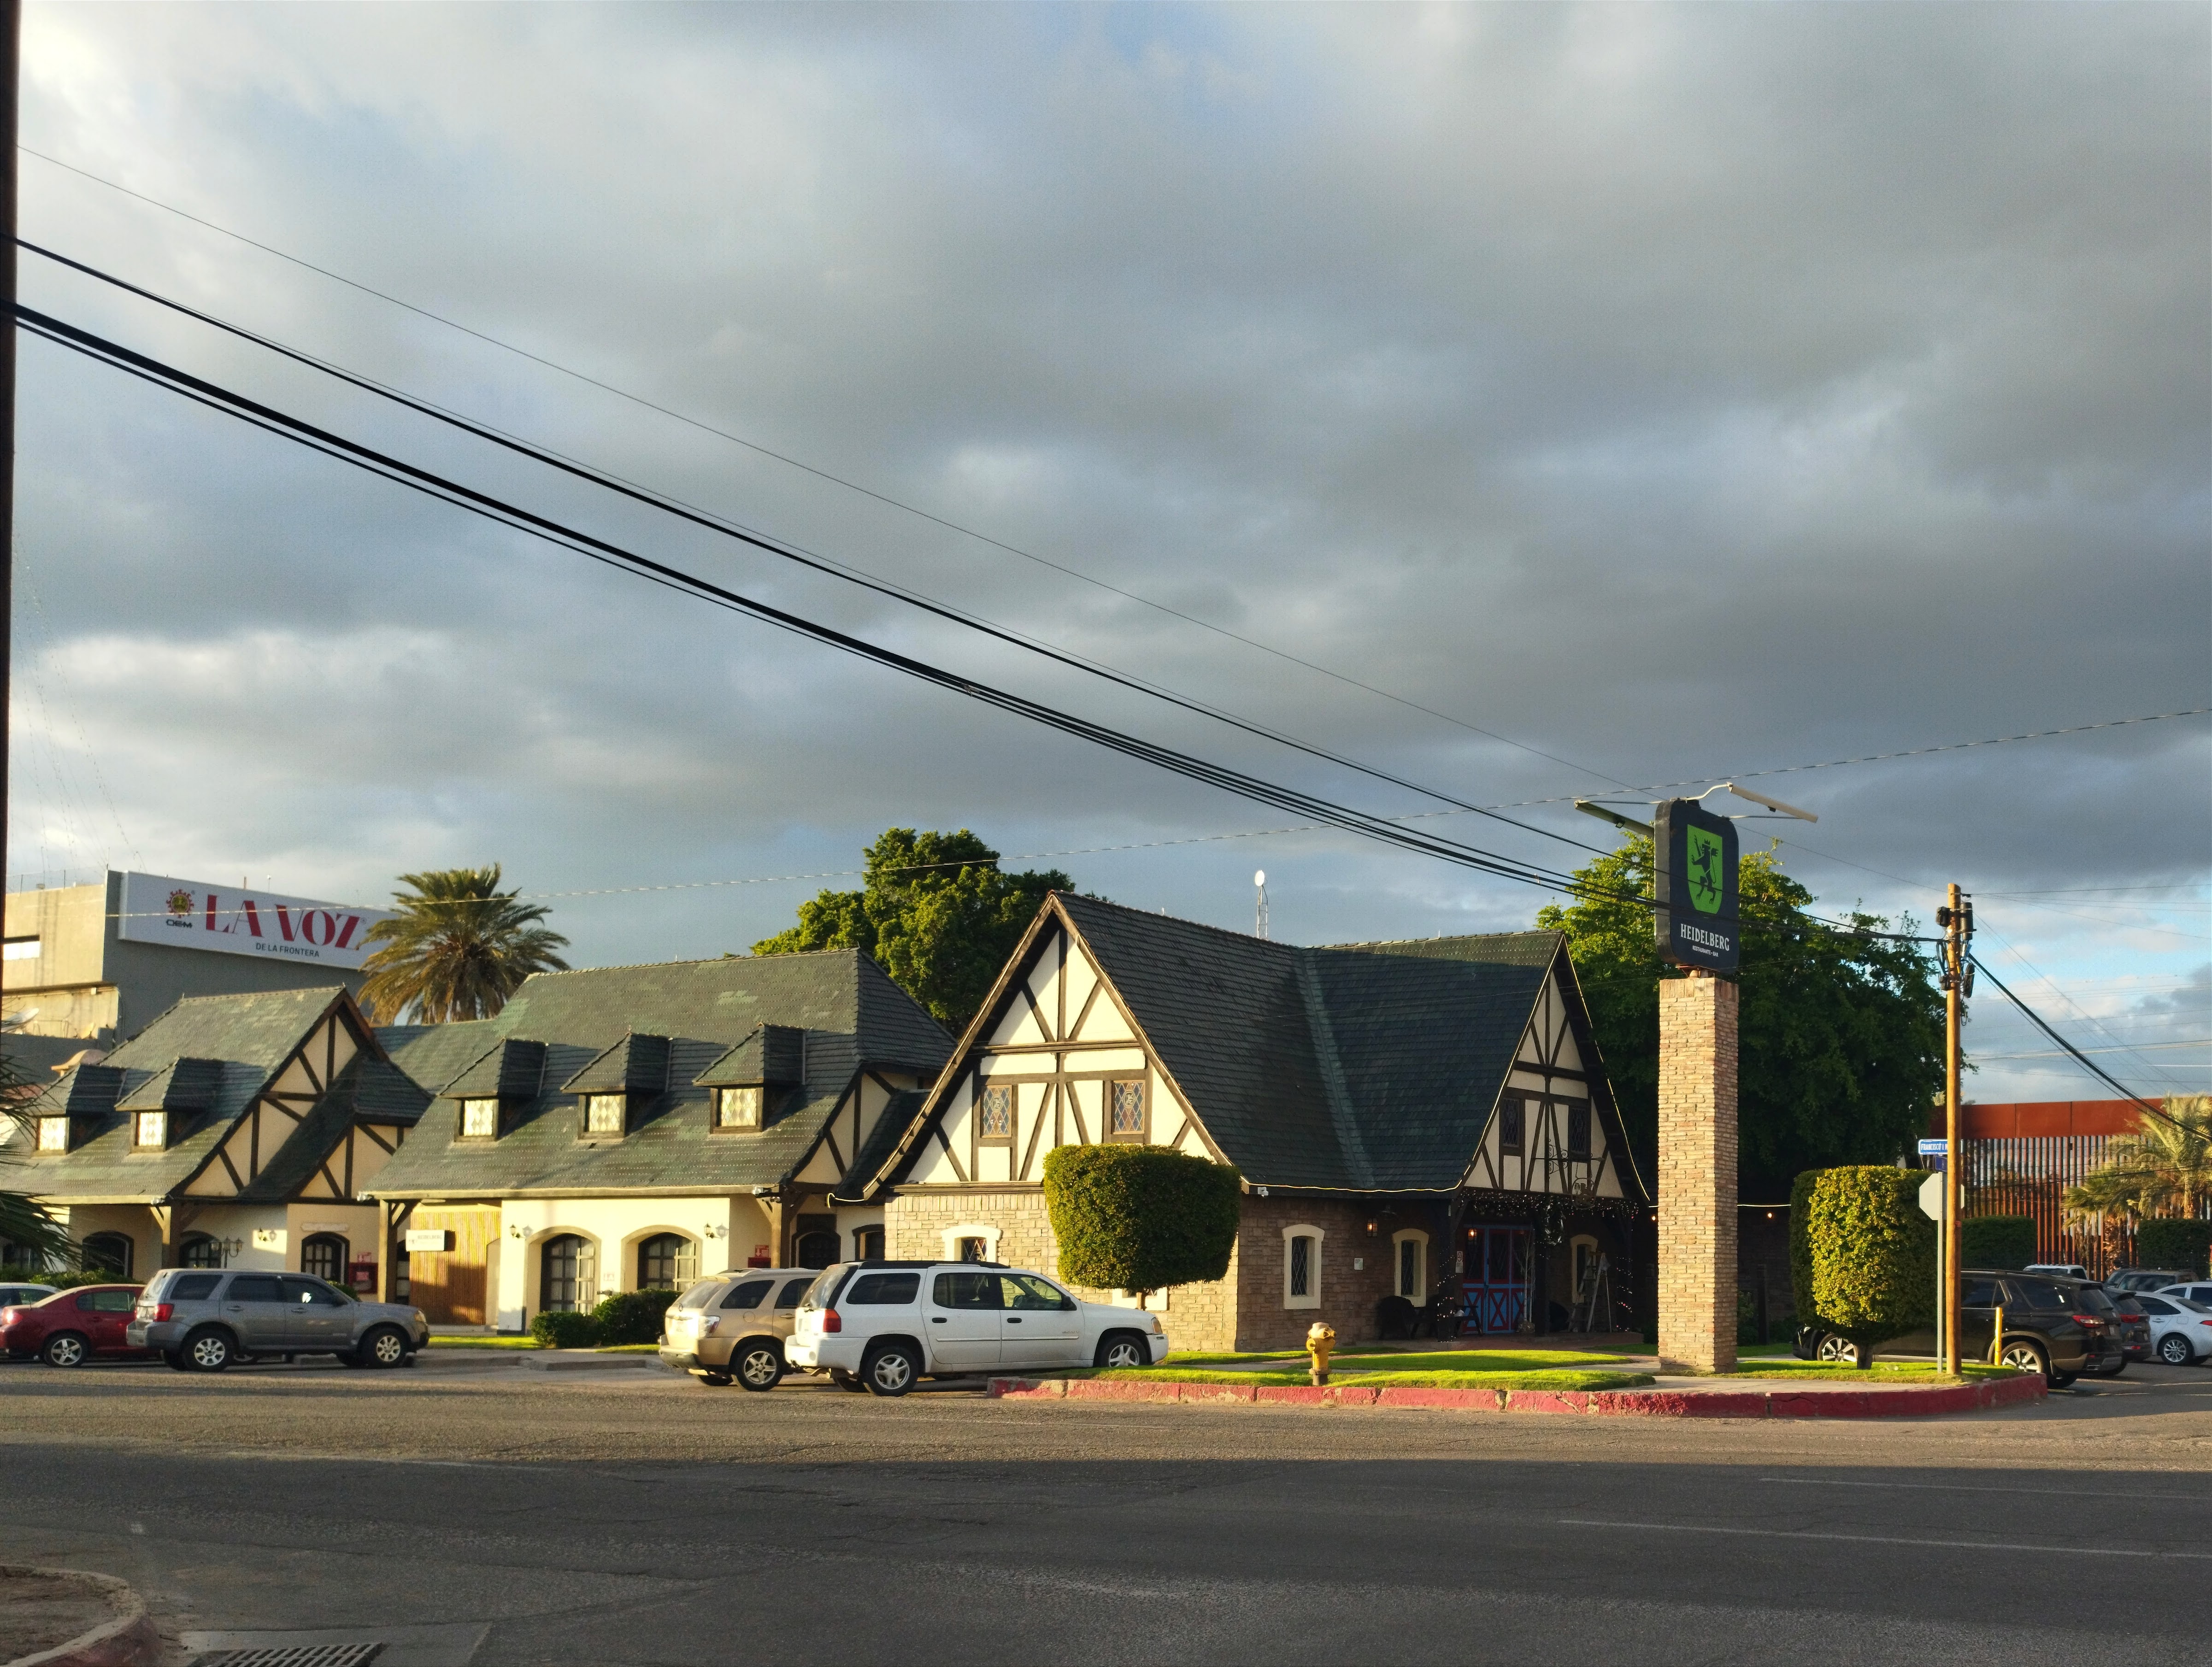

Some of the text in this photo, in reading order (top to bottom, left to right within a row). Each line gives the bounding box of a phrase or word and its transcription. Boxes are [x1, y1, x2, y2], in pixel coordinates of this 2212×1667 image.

[206, 894, 359, 951] LA VOZ
[256, 942, 266, 951] DE
[280, 945, 319, 957] FRONTERA
[1680, 923, 1730, 951] HEIDELBERG
